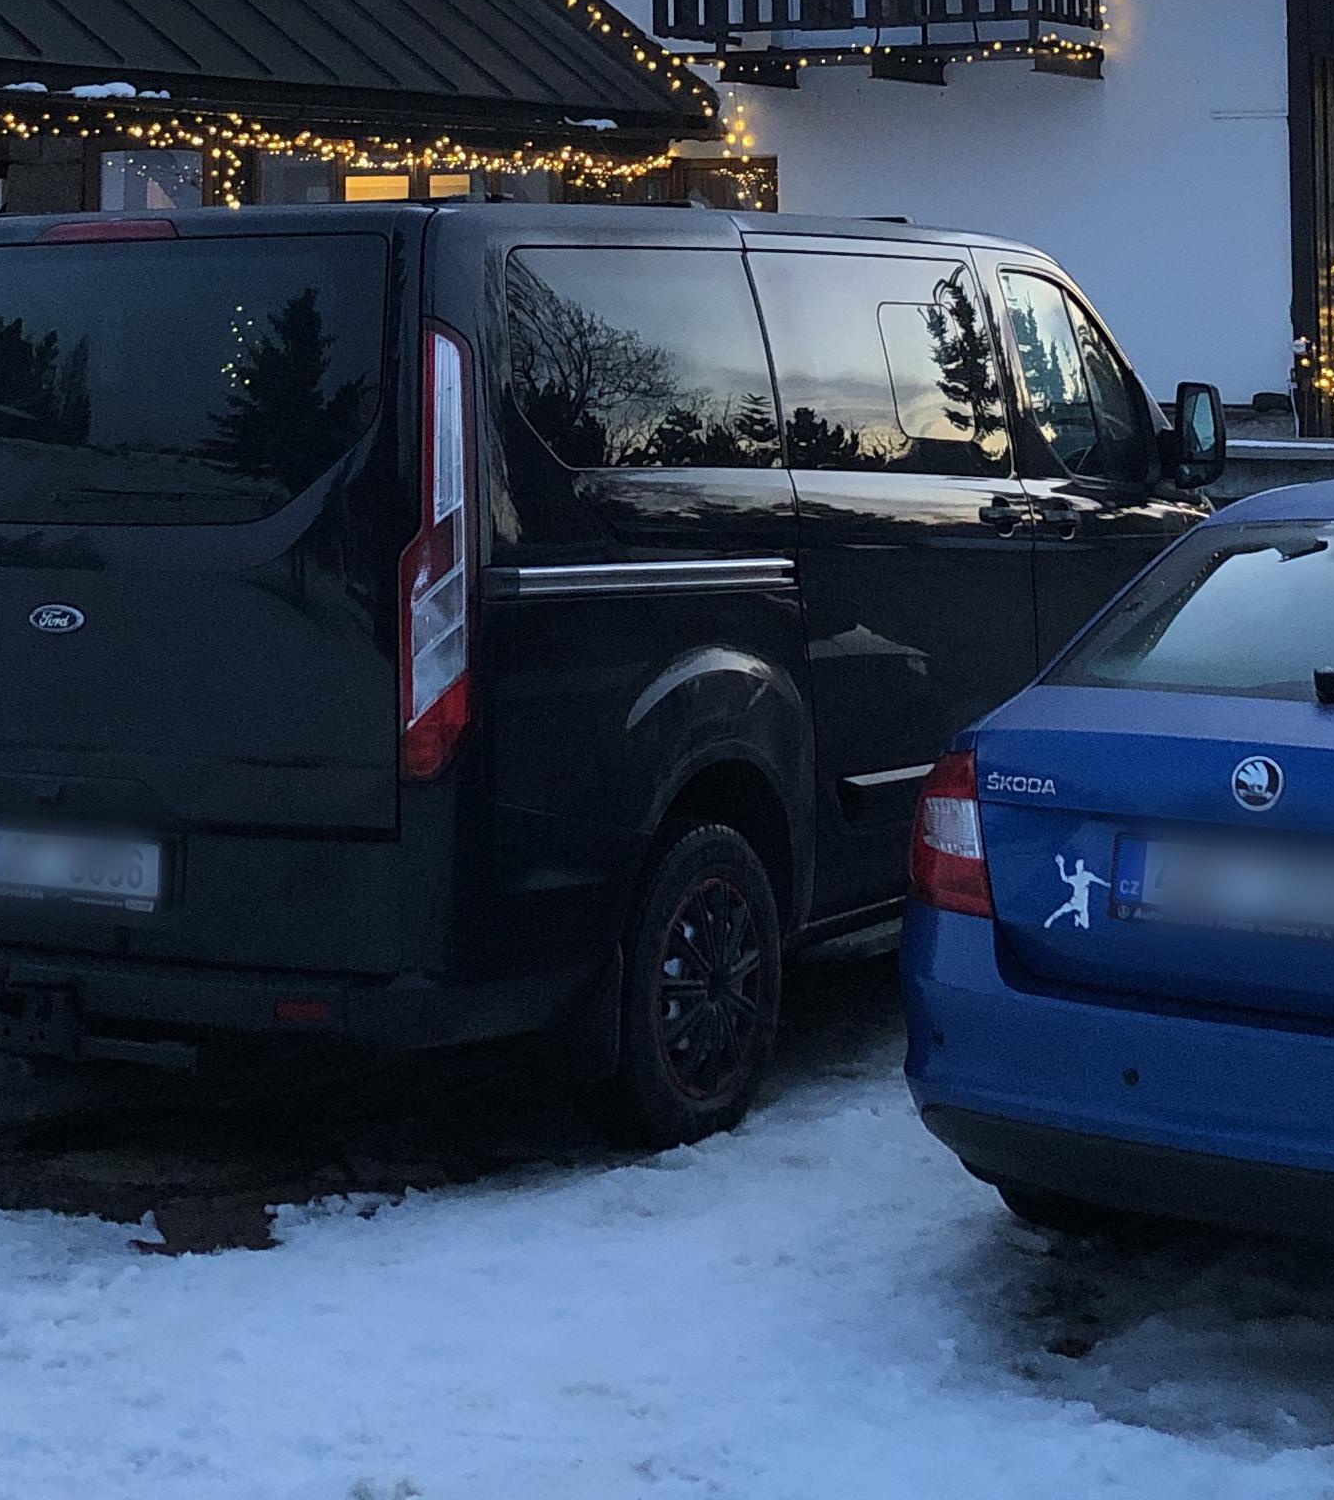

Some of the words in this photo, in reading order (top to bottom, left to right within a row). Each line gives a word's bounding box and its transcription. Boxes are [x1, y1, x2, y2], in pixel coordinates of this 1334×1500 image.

[39, 610, 70, 627] Ford
[986, 772, 1056, 796] ŠKODA
[1120, 879, 1140, 895] CZ
